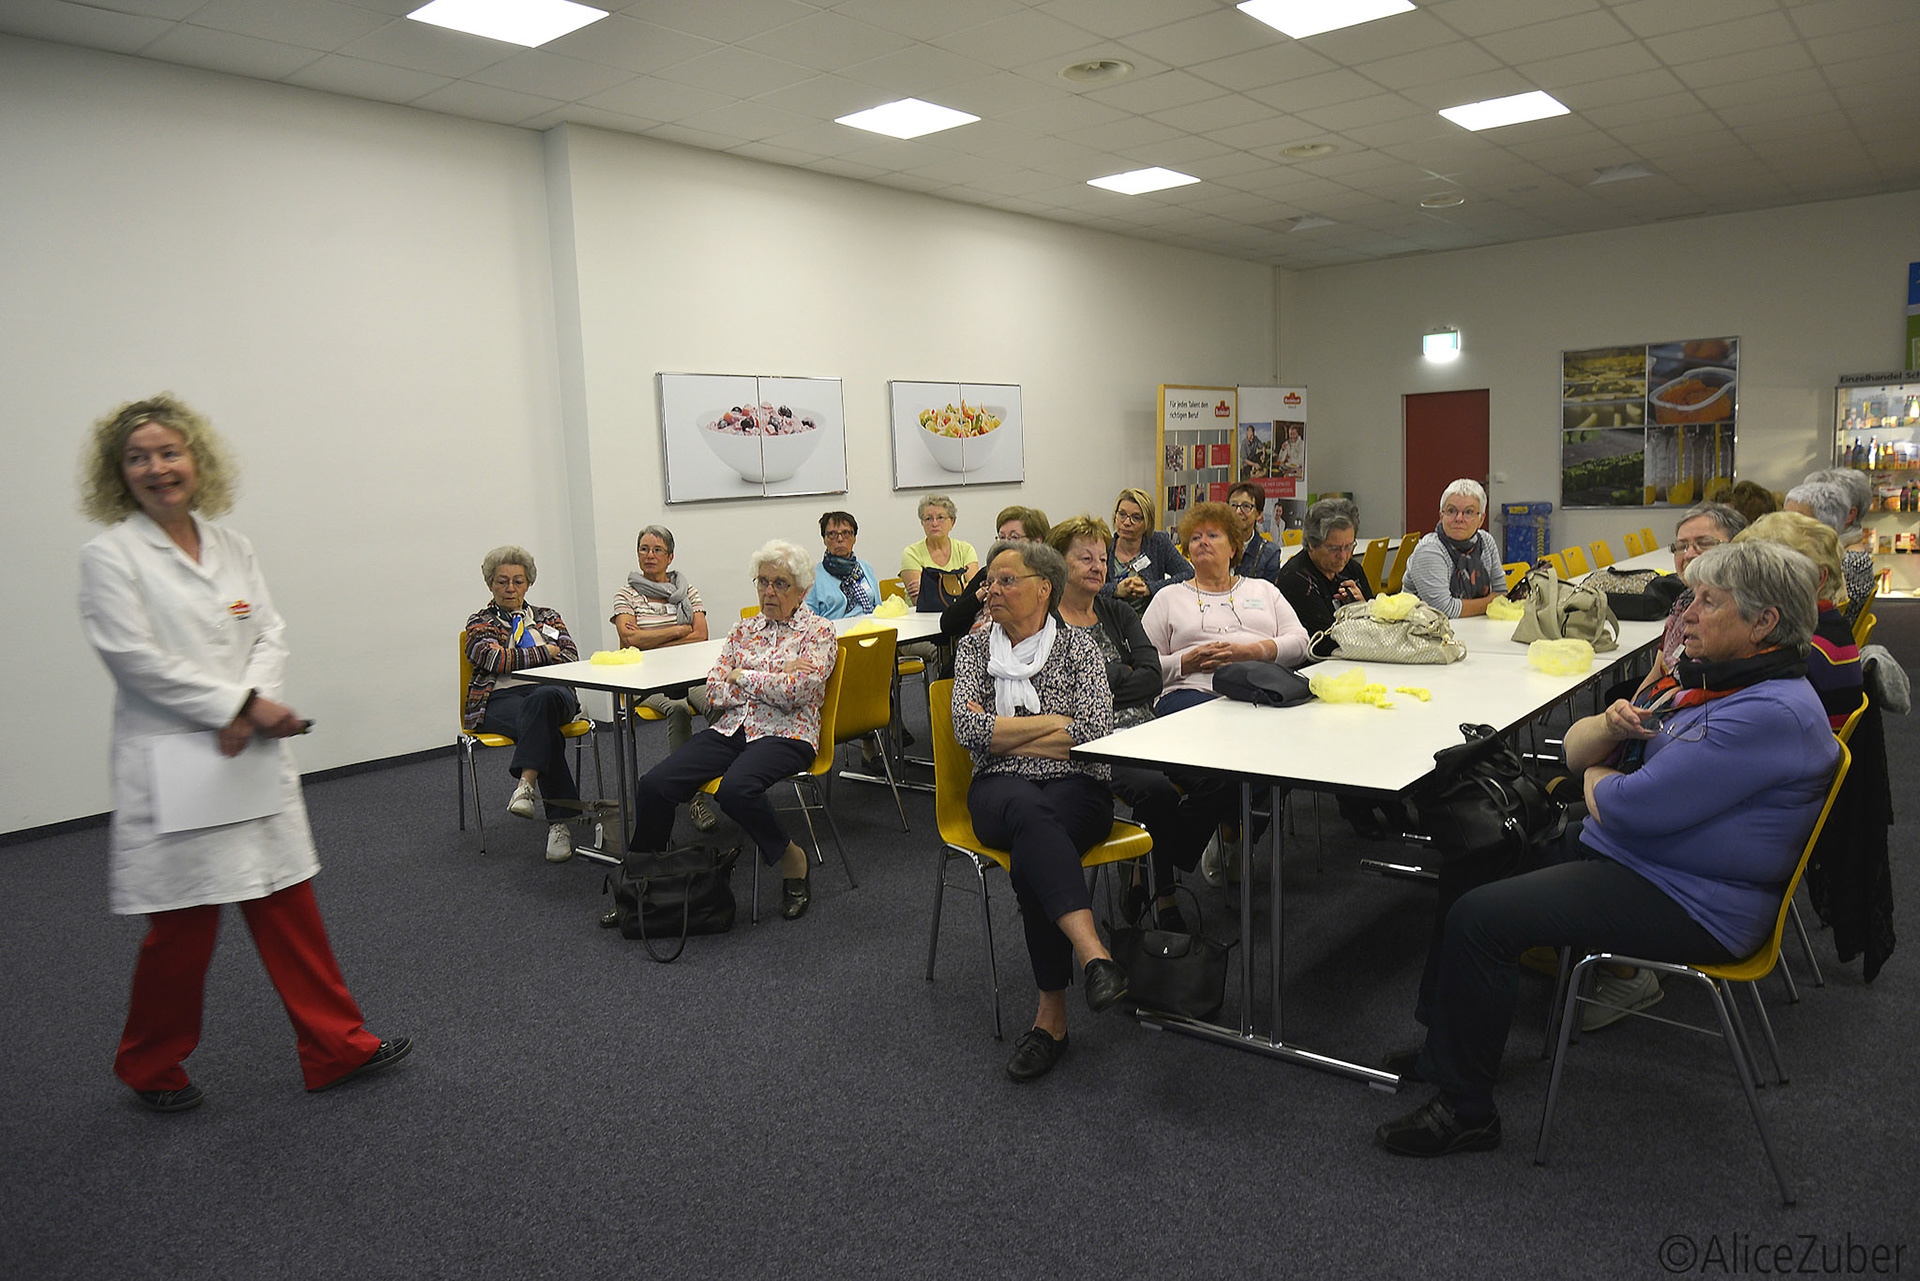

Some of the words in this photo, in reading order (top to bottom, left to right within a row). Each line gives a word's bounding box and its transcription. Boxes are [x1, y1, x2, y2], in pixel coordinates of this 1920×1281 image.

[1840, 371, 1902, 383] Einzelhandel
[1177, 401, 1188, 409] jedes
[1188, 400, 1200, 408] Talent
[1201, 400, 1209, 408] den
[1170, 411, 1187, 420] richtigen
[1188, 411, 1199, 419] Beruf
